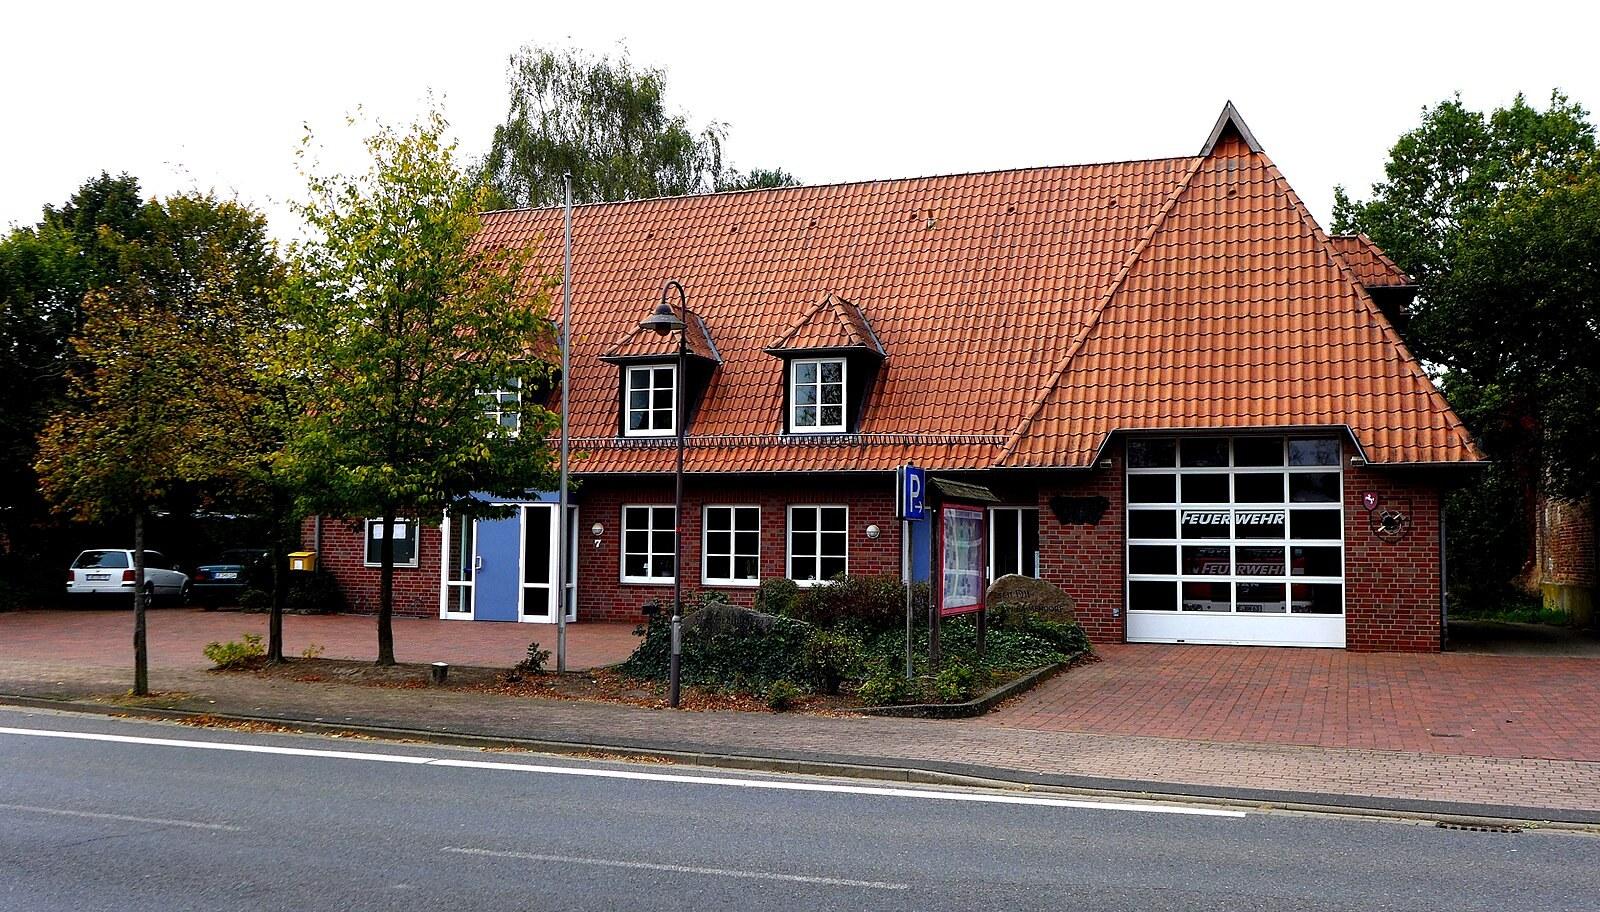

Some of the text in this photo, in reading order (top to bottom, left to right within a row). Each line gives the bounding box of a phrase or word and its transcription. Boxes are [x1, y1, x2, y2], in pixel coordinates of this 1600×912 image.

[910, 474, 921, 512] P
[1181, 511, 1285, 525] FEUERWEHR
[594, 539, 602, 548] 7
[1202, 562, 1285, 575] FEURWEHR
